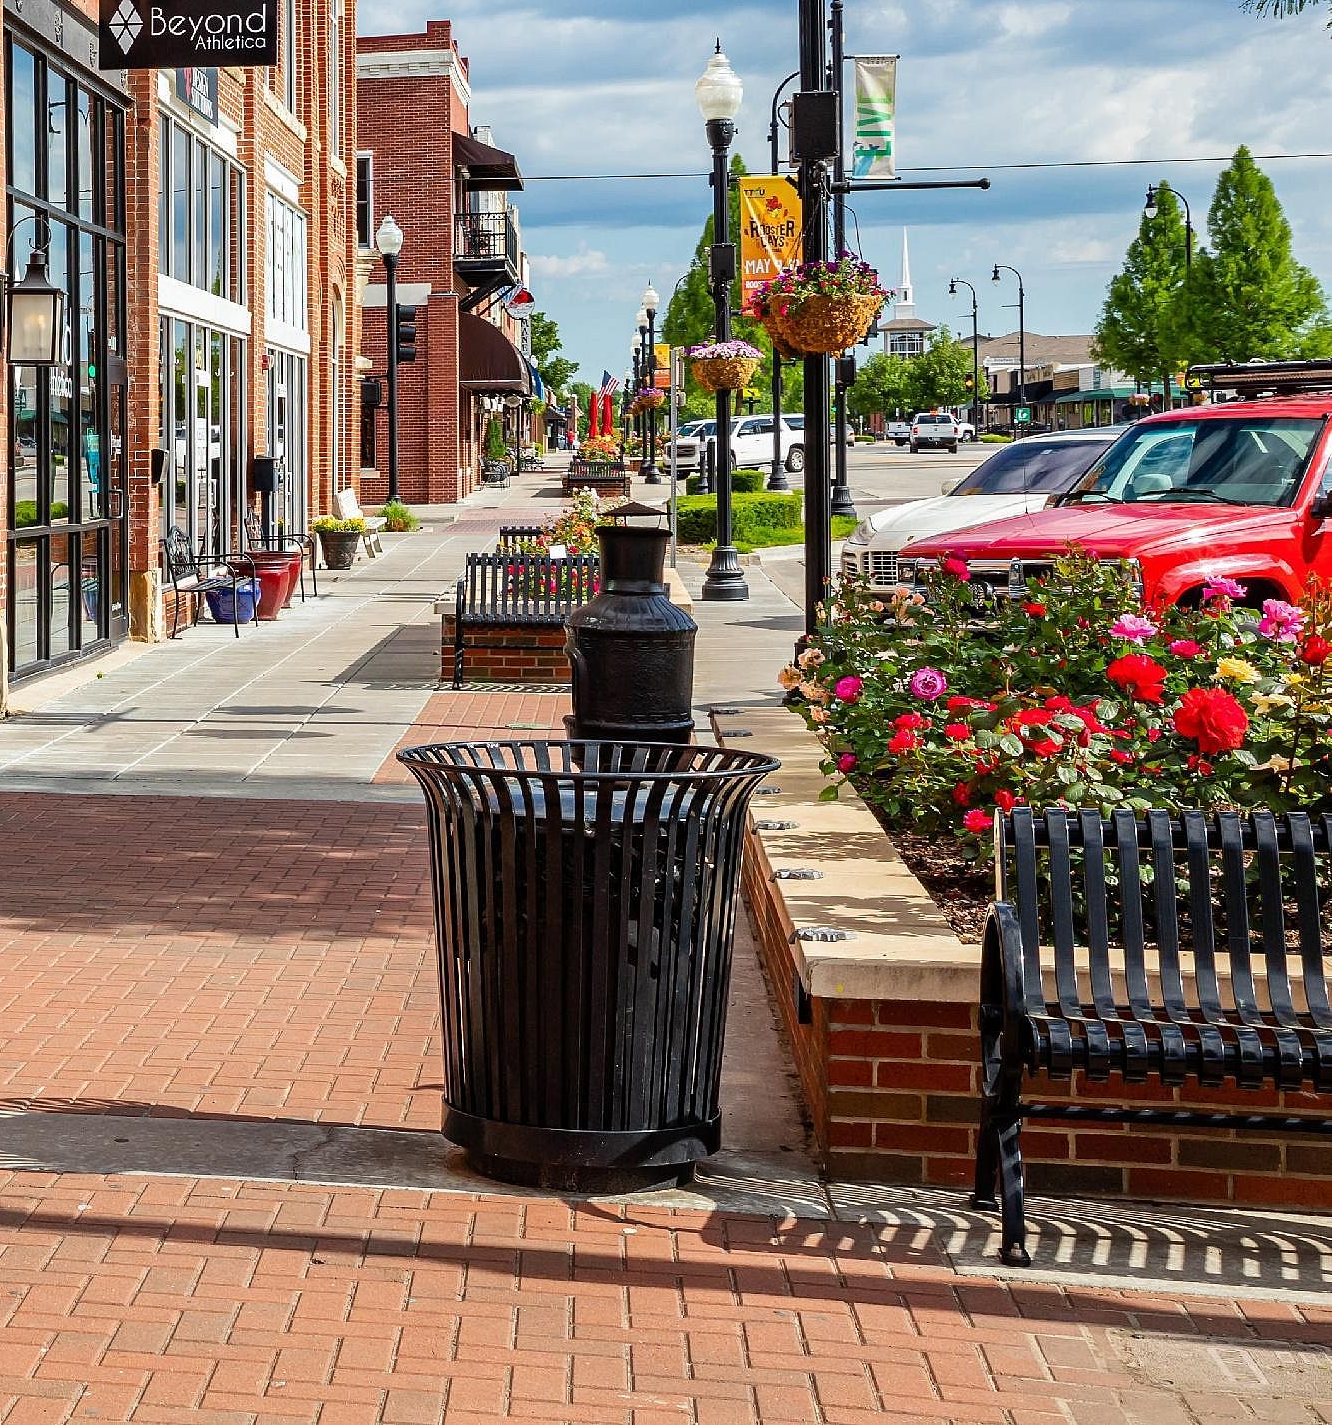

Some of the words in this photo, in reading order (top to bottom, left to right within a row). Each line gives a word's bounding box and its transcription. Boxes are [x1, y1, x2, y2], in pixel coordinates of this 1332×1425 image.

[150, 3, 266, 41] Beyond
[194, 34, 267, 51] Athletica
[854, 87, 892, 157] LIVE
[750, 220, 795, 238] ROOSTER
[745, 258, 771, 275] MAY
